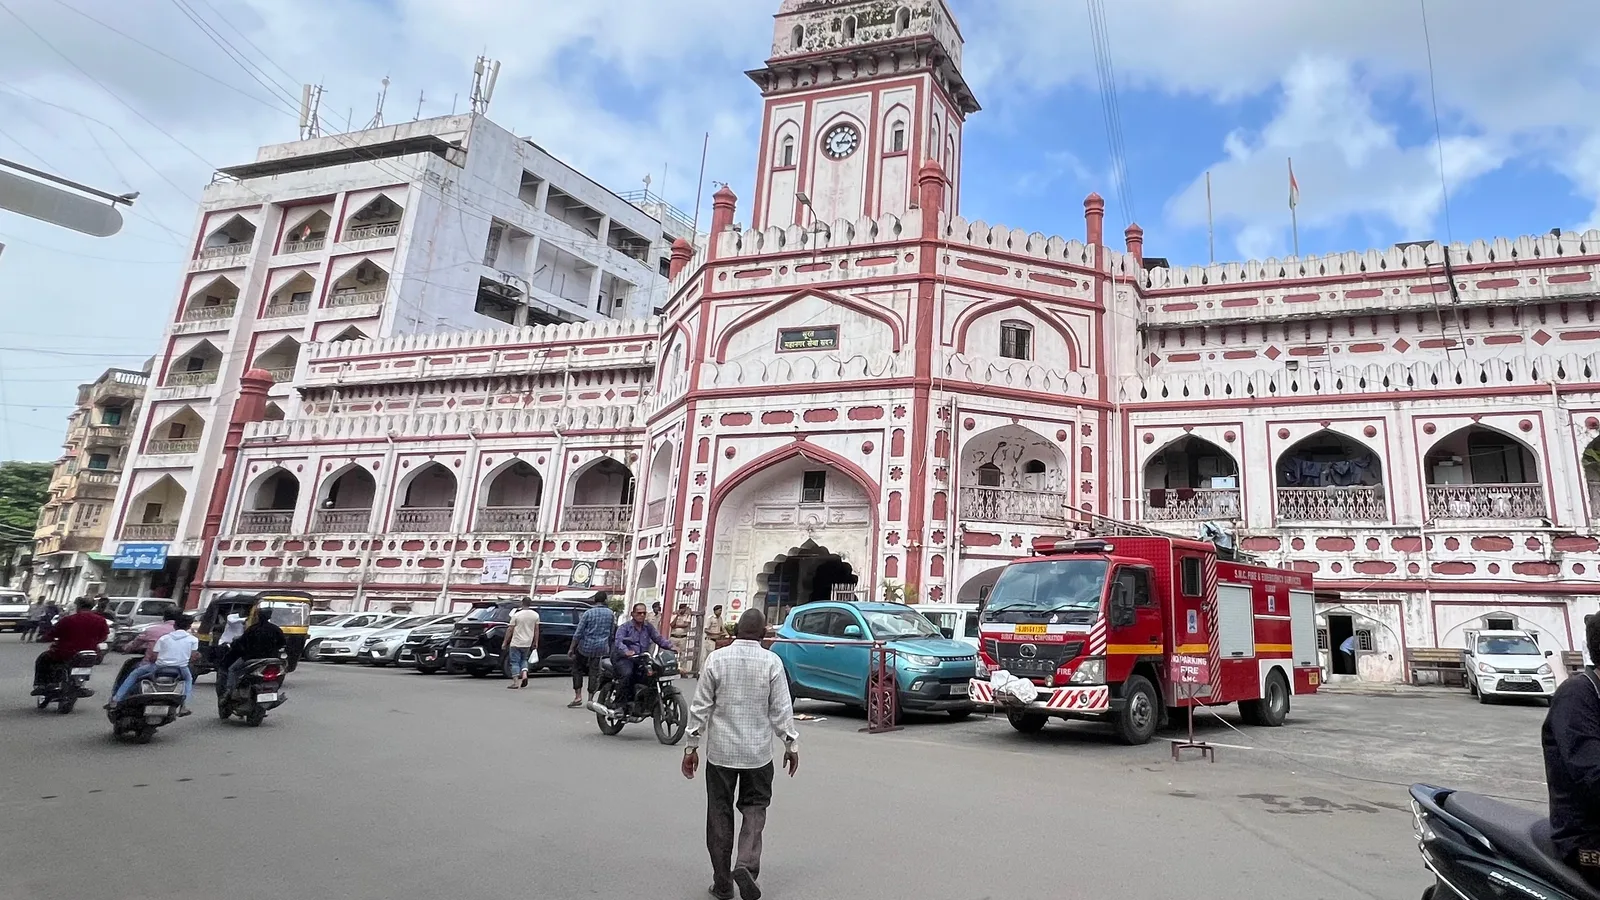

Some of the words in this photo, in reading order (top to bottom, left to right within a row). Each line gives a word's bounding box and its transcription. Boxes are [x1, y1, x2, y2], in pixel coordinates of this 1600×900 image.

[1180, 655, 1207, 666] PARKING
[1057, 667, 1072, 676] FIRE
[1180, 665, 1199, 675] FIRE
